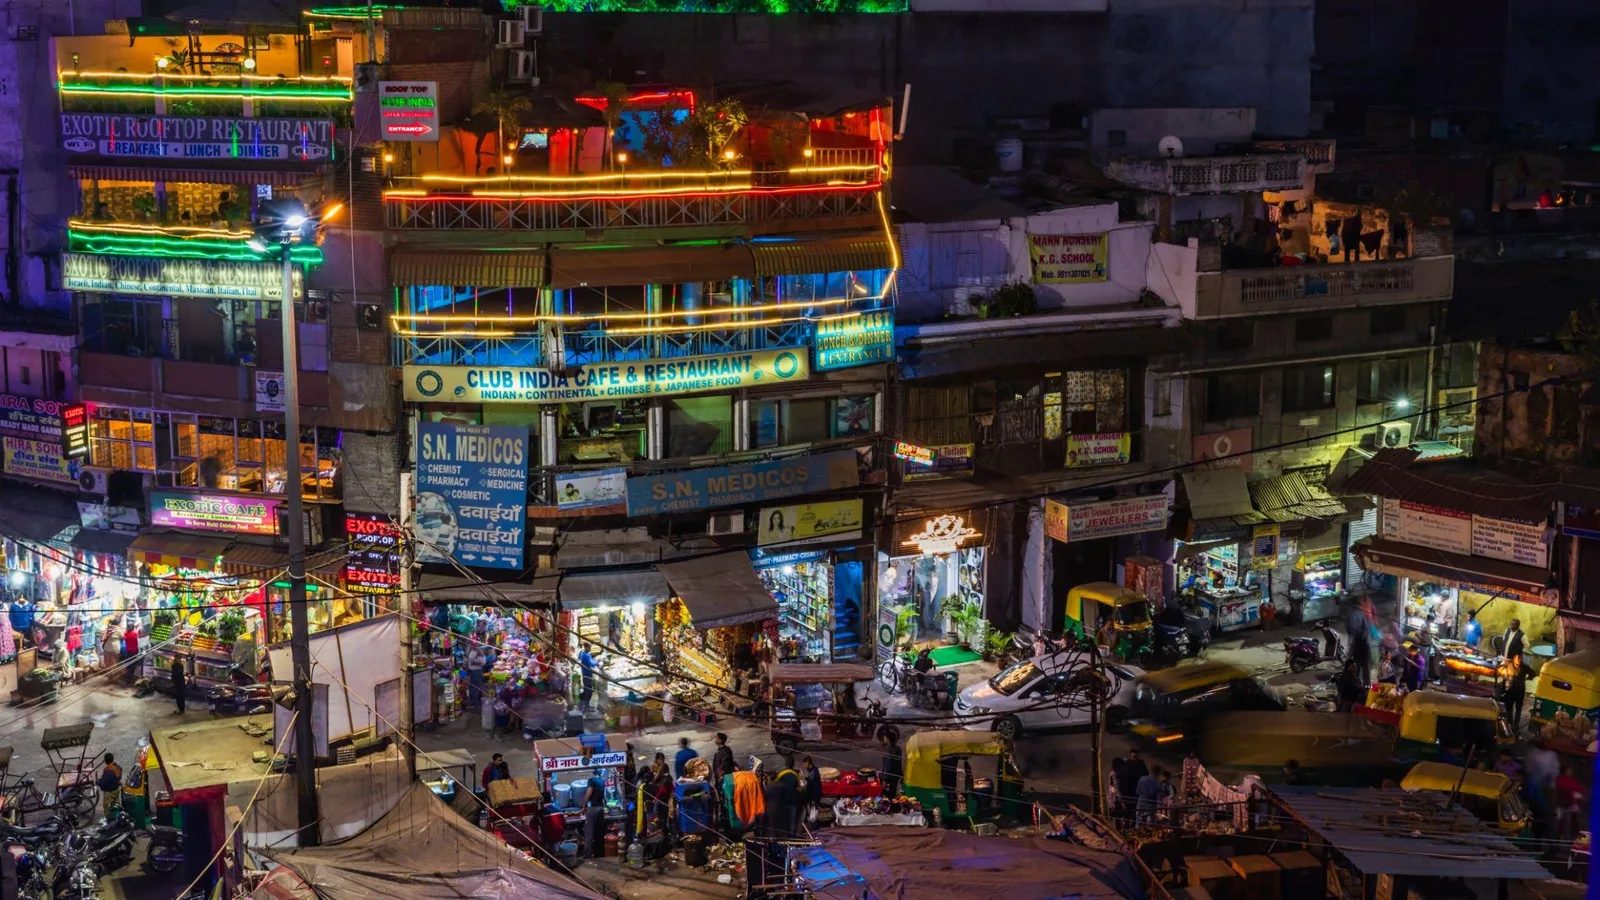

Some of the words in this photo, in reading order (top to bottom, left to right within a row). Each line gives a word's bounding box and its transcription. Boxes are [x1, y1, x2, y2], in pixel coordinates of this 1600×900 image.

[381, 96, 406, 107] CLUB
[408, 97, 435, 107] INDIA
[61, 115, 120, 137] EXOTIC
[125, 117, 207, 140] ROOFTOP
[211, 119, 329, 142] RESTAURANT
[107, 142, 168, 156] BREAKFAST
[184, 145, 220, 157] LUNCH
[238, 145, 279, 157] DINNER
[1032, 236, 1060, 246] MANN
[1062, 235, 1102, 246] NURSERY
[1039, 254, 1060, 264] K.G.
[1061, 253, 1095, 264] SCHOOL
[63, 253, 110, 278] EXOTIC
[110, 256, 167, 282] ROOFTOP
[817, 335, 847, 351] LUNCH
[848, 333, 856, 347] &
[858, 330, 892, 346] DINNER
[829, 349, 883, 365] ENTRANCE
[467, 369, 514, 388] CLUB
[519, 371, 569, 389] INDIA
[574, 366, 620, 387] CAFE
[626, 365, 638, 383] &
[644, 355, 753, 382] RESTAURANT
[481, 390, 516, 400] INDIAN
[525, 388, 598, 400] CONTINENTAL
[607, 385, 651, 396] CHINESE
[654, 384, 662, 392] &
[664, 379, 718, 392] JAPANESE
[720, 376, 746, 387] FOOD
[0, 396, 31, 413] IRA
[65, 407, 84, 419] EXOTIC
[0, 420, 20, 430] READY
[22, 424, 41, 433] MADE
[1072, 433, 1093, 442] MANN
[1094, 431, 1124, 441] NURSERY
[6, 438, 32, 450] HIRA
[36, 442, 64, 456] SONS
[422, 433, 451, 460] S.N.
[455, 434, 523, 466] MEDICOS
[1093, 445, 1119, 454] SCHOOL
[427, 464, 461, 474] CHEMIST
[487, 467, 526, 478] SERGICAL
[427, 475, 469, 487] PHARMACY
[486, 479, 524, 491] MEDICINE
[652, 480, 701, 501] S.N.
[707, 465, 809, 495] MEDICOS
[451, 489, 490, 501] COSMETIC
[661, 498, 700, 511] CHEMIST
[709, 491, 756, 507] PHARMACY
[164, 498, 223, 514] EXOTIC
[224, 503, 267, 518] CAFÉ
[459, 503, 522, 522] दवाईयाँ
[1085, 512, 1149, 529] JEWELLERS
[458, 526, 522, 545] दवाईयाँ
[545, 755, 559, 770] श्री
[560, 757, 579, 768] नाथ
